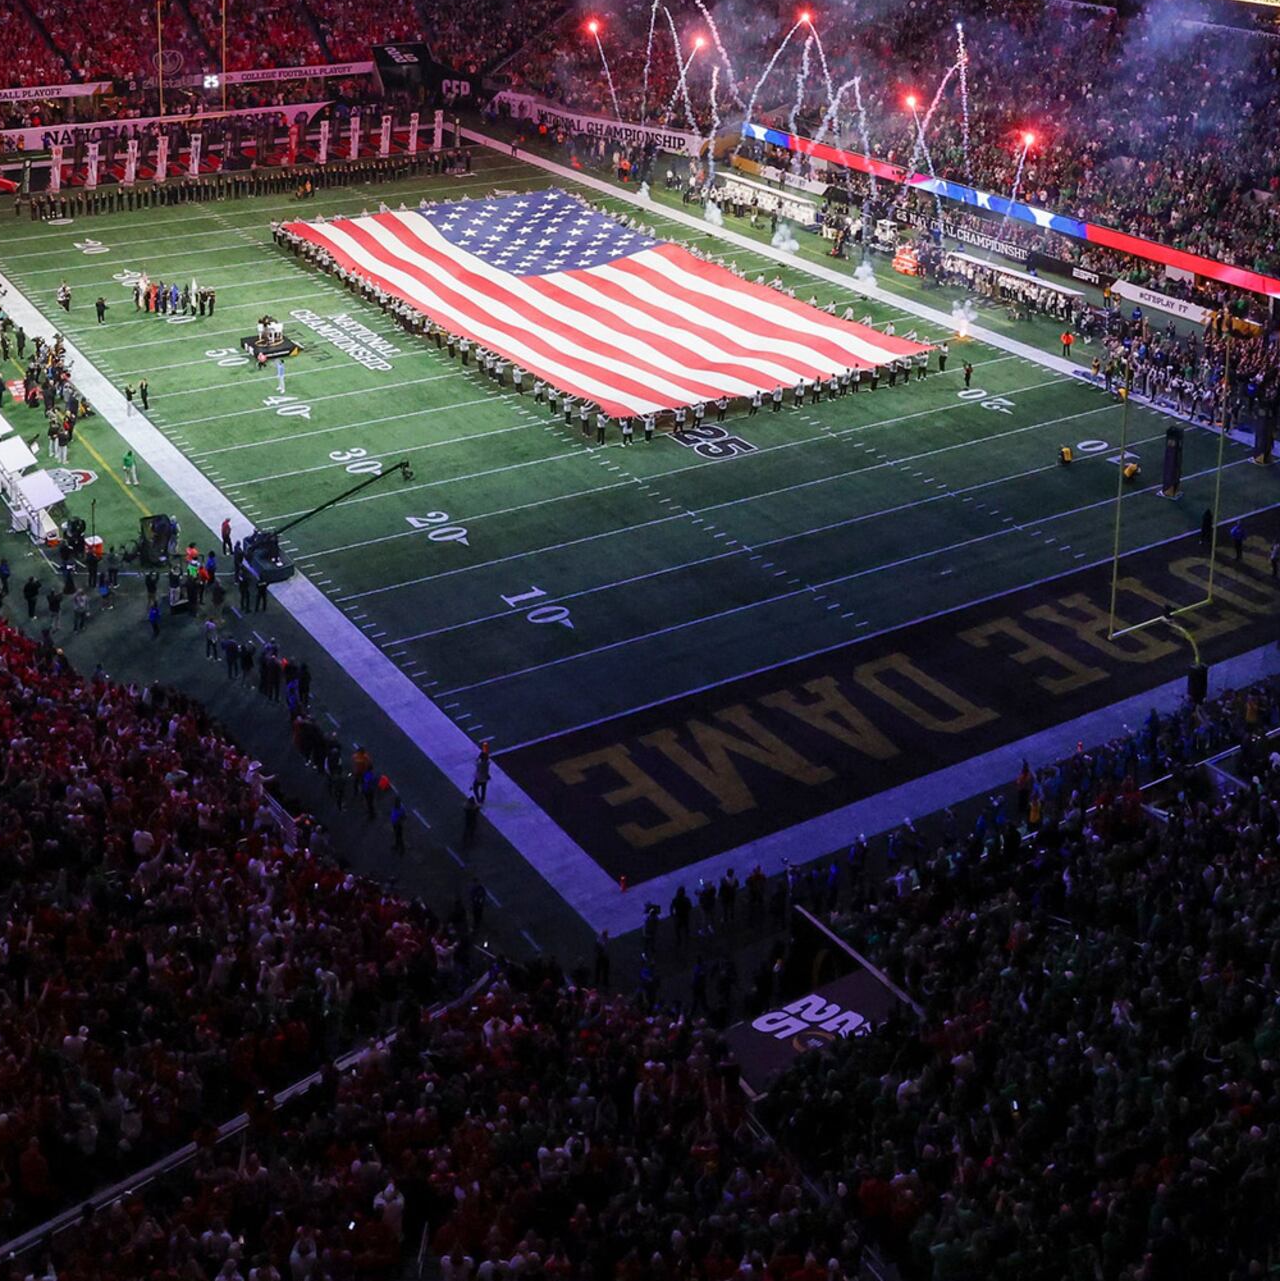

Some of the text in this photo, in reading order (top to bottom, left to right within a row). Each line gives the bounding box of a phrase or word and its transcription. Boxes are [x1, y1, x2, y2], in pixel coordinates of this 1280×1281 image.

[204, 75, 219, 89] 25
[241, 66, 352, 81] COLLEGE FOOTBALL PLAYOFF
[21, 88, 62, 99] PLAYOFF
[440, 79, 471, 97] CFP
[586, 121, 686, 151] CHAMPIONSHIP
[1073, 267, 1100, 284] ESPN
[290, 308, 394, 371] CHAMPIONSHIP
[326, 313, 402, 358] NATIONAL
[205, 347, 250, 368] 50
[262, 395, 312, 420] 40
[957, 388, 1017, 415] 20
[665, 424, 759, 460] 25
[328, 446, 383, 476] 30
[405, 510, 470, 547] 20
[500, 584, 575, 630] 10
[551, 651, 1001, 850] DAME
